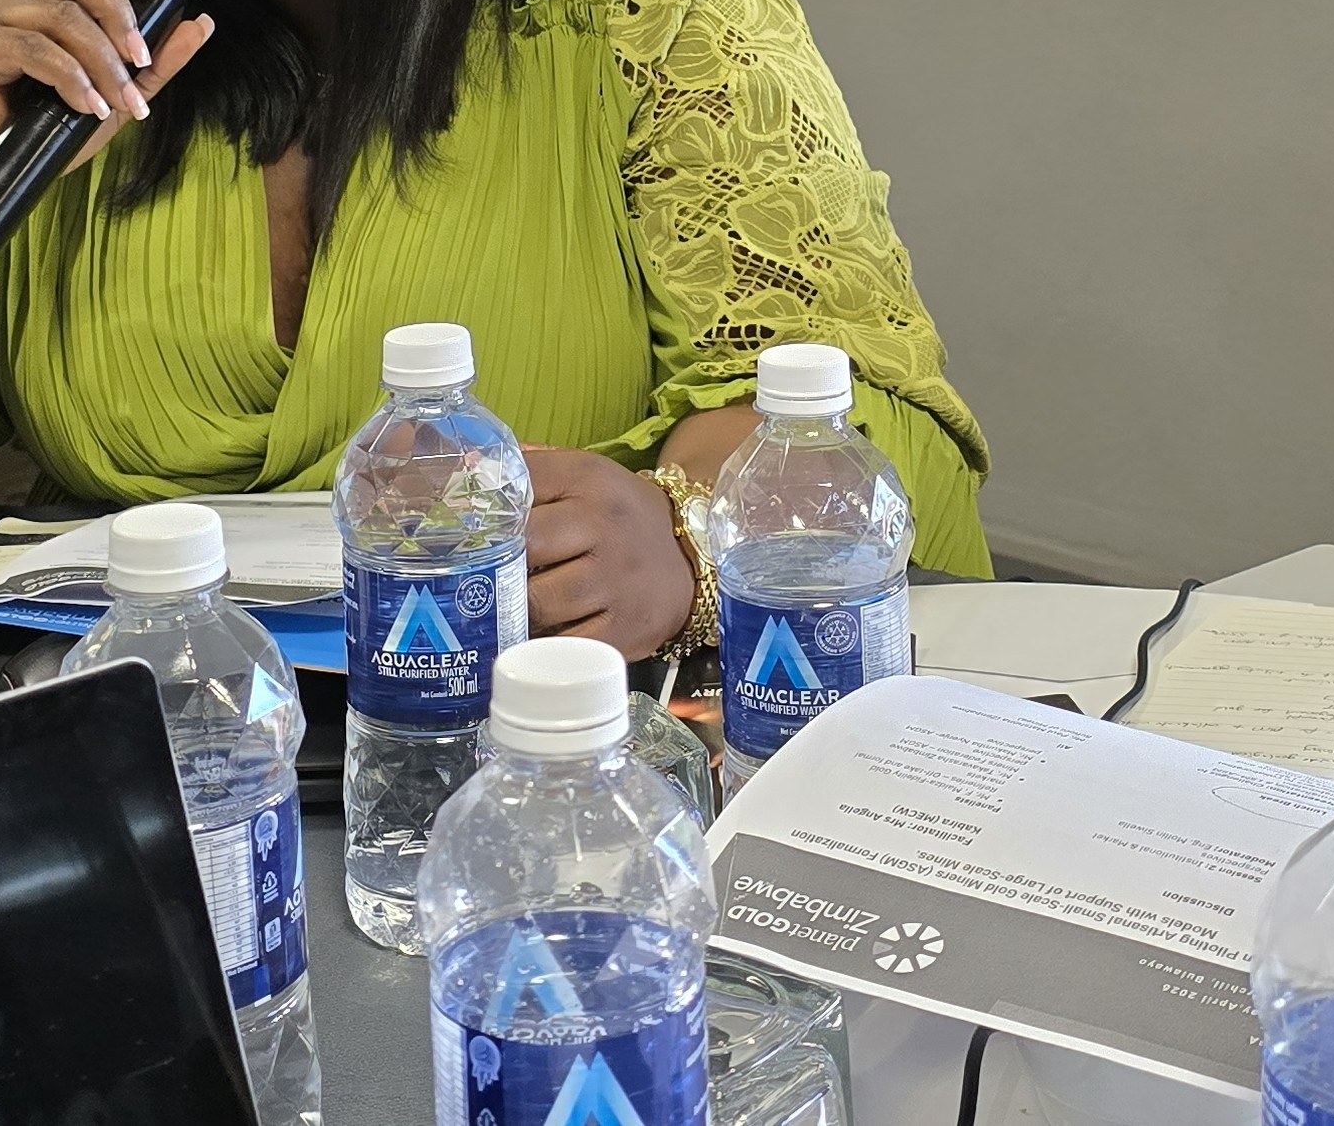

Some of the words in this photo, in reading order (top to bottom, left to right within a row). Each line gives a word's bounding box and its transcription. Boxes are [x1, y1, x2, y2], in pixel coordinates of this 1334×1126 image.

[371, 649, 479, 669] AQUACLEAR
[378, 665, 398, 677] STILL
[399, 667, 439, 678] PURIFIED
[440, 665, 470, 677] WATER
[448, 676, 466, 696] 500
[467, 673, 479, 693] ml
[736, 679, 840, 705] AQUACLEAR
[741, 696, 758, 710] STILL
[760, 702, 798, 716] PURIFIED
[854, 752, 884, 763] formal
[890, 742, 937, 759] Zimbabwe
[973, 746, 1028, 765] perspective
[987, 739, 1043, 757] perspective
[937, 748, 987, 768] Federation
[988, 761, 1020, 772] Miners
[869, 765, 892, 774] Gold
[967, 773, 1005, 785] markets
[951, 777, 998, 793] Refineries
[955, 792, 1001, 812] Panelists
[1259, 792, 1291, 806] Break
[839, 804, 883, 821] Angella
[893, 805, 940, 824] (MECW)
[1294, 804, 1327, 815] Lunch
[884, 817, 906, 828] Mrs
[942, 819, 982, 834] Kabira
[908, 823, 973, 845] Facilitator:
[1092, 833, 1128, 847] Market
[791, 830, 878, 860] Formalization
[1191, 840, 1212, 850] Eng.
[880, 853, 933, 876] (ASGM)
[918, 851, 960, 869] Mines.
[1139, 846, 1203, 867] Institutional
[1201, 849, 1269, 875] Perspectives
[936, 871, 983, 889] Miners
[963, 864, 1045, 897] Large-Scale
[1219, 868, 1262, 883] Session
[984, 884, 1017, 898] Gold
[1045, 886, 1063, 894] of
[734, 876, 880, 934] Zimbabwe
[1021, 891, 1106, 921] Small-Scale
[1065, 891, 1123, 912] Support
[1163, 891, 1234, 916] Discussion
[1126, 907, 1157, 920] with
[728, 898, 861, 951] planetGOLD
[1107, 916, 1177, 940] Artisanal
[1161, 917, 1218, 939] Models
[1179, 934, 1239, 960] Piloting
[1139, 959, 1204, 983] Bulawayo
[1163, 984, 1197, 999] 2026
